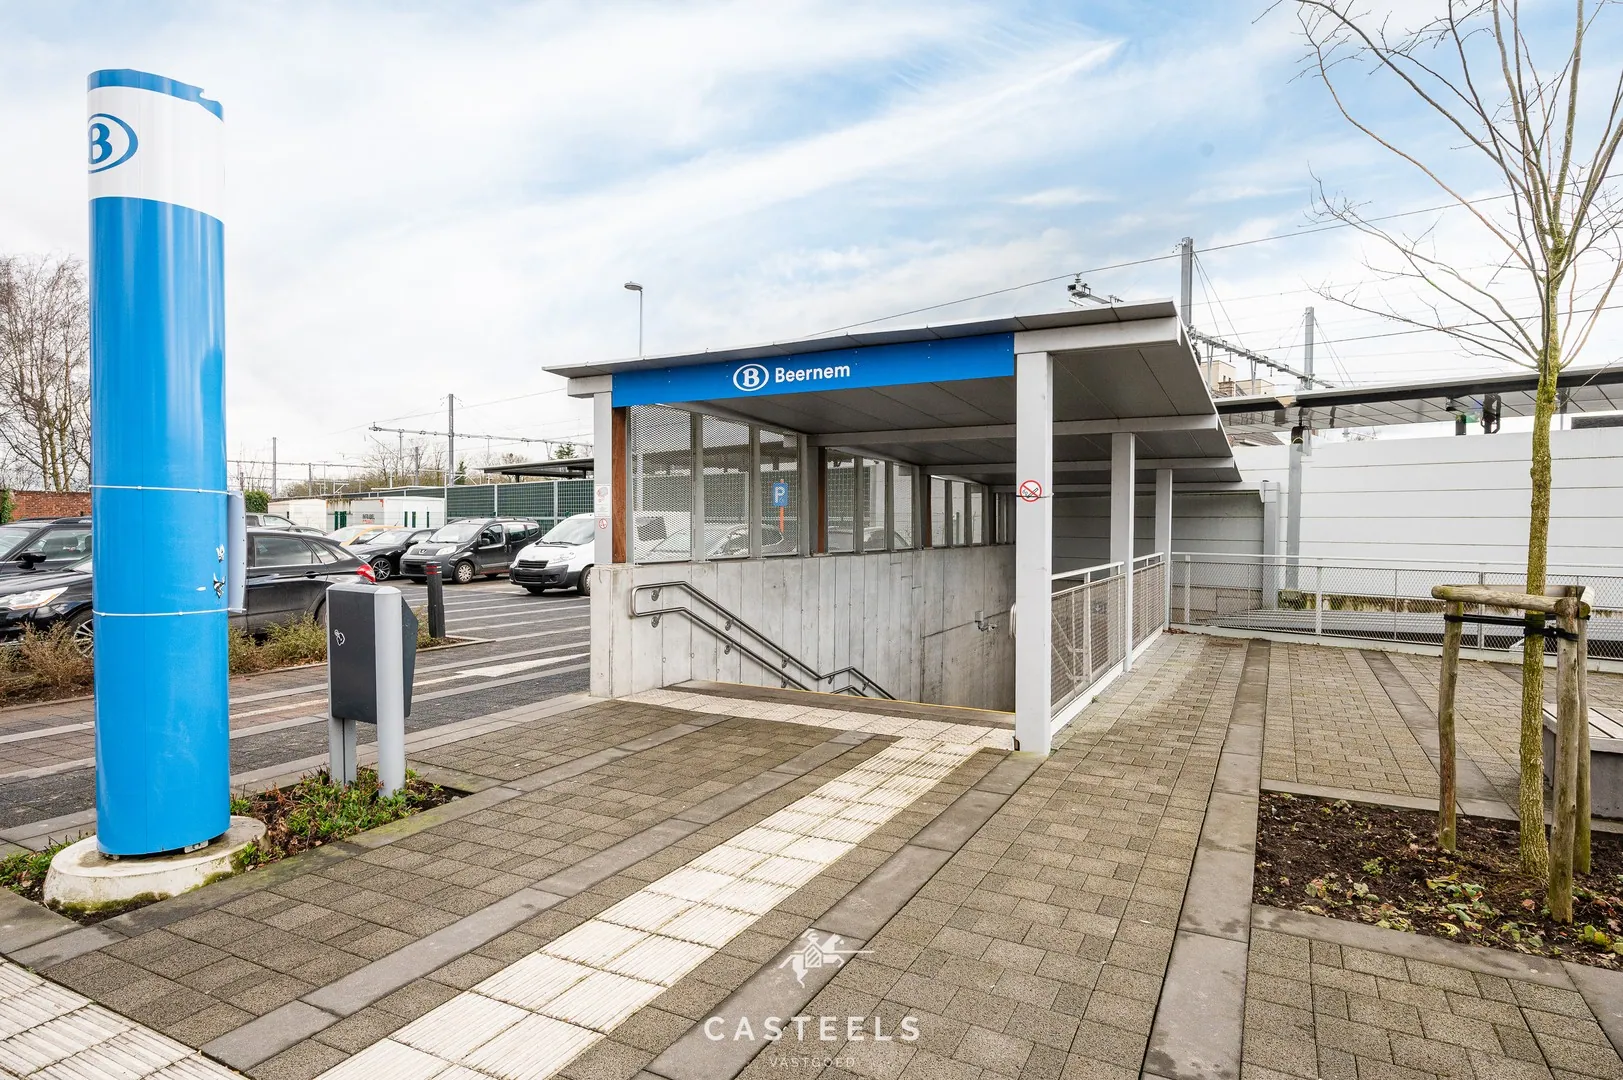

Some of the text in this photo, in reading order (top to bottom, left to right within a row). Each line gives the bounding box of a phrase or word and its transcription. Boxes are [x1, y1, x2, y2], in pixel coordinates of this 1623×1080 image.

[88, 122, 113, 165] B
[775, 365, 851, 384] Beernem
[774, 486, 786, 503] P
